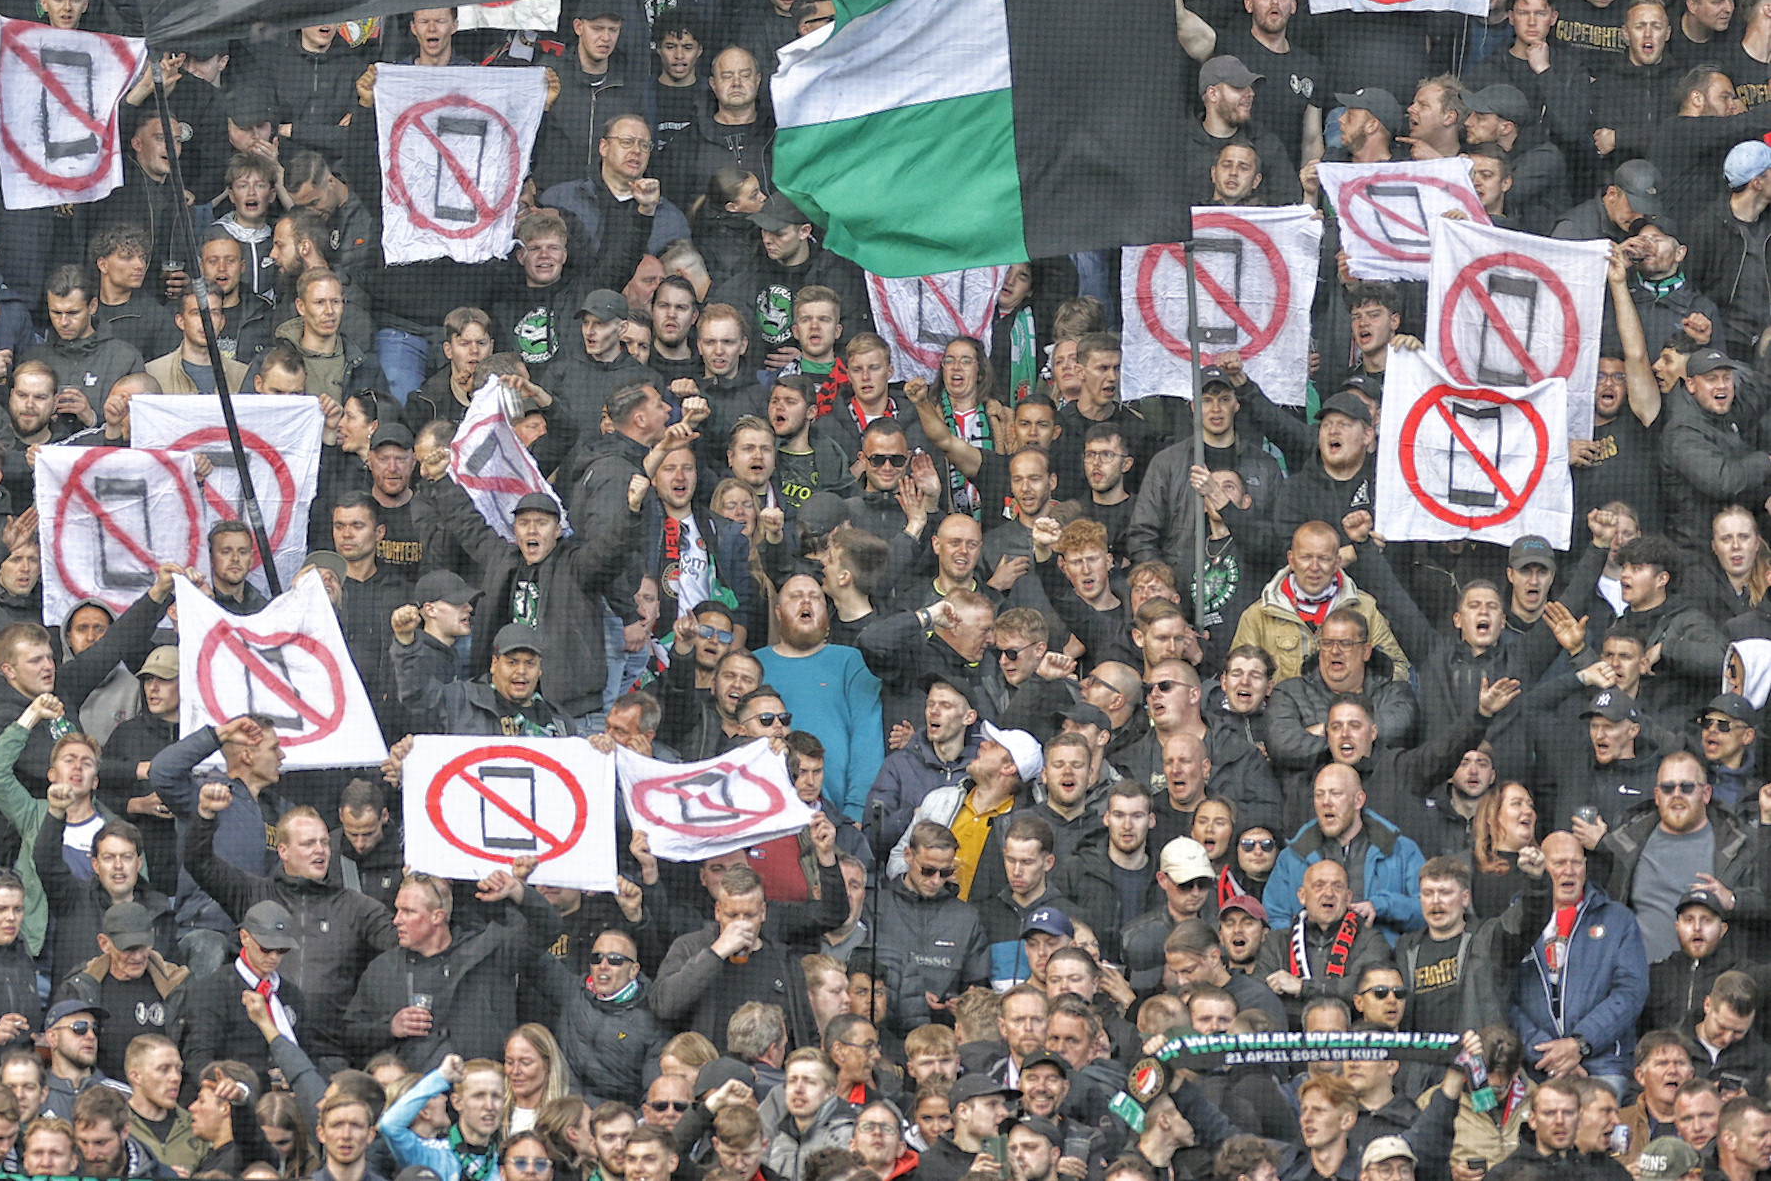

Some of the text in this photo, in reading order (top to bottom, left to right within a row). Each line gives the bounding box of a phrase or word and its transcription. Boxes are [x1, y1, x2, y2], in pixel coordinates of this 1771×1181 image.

[1224, 1048, 1389, 1065] 21 APRIL 2024 DE KUIP
